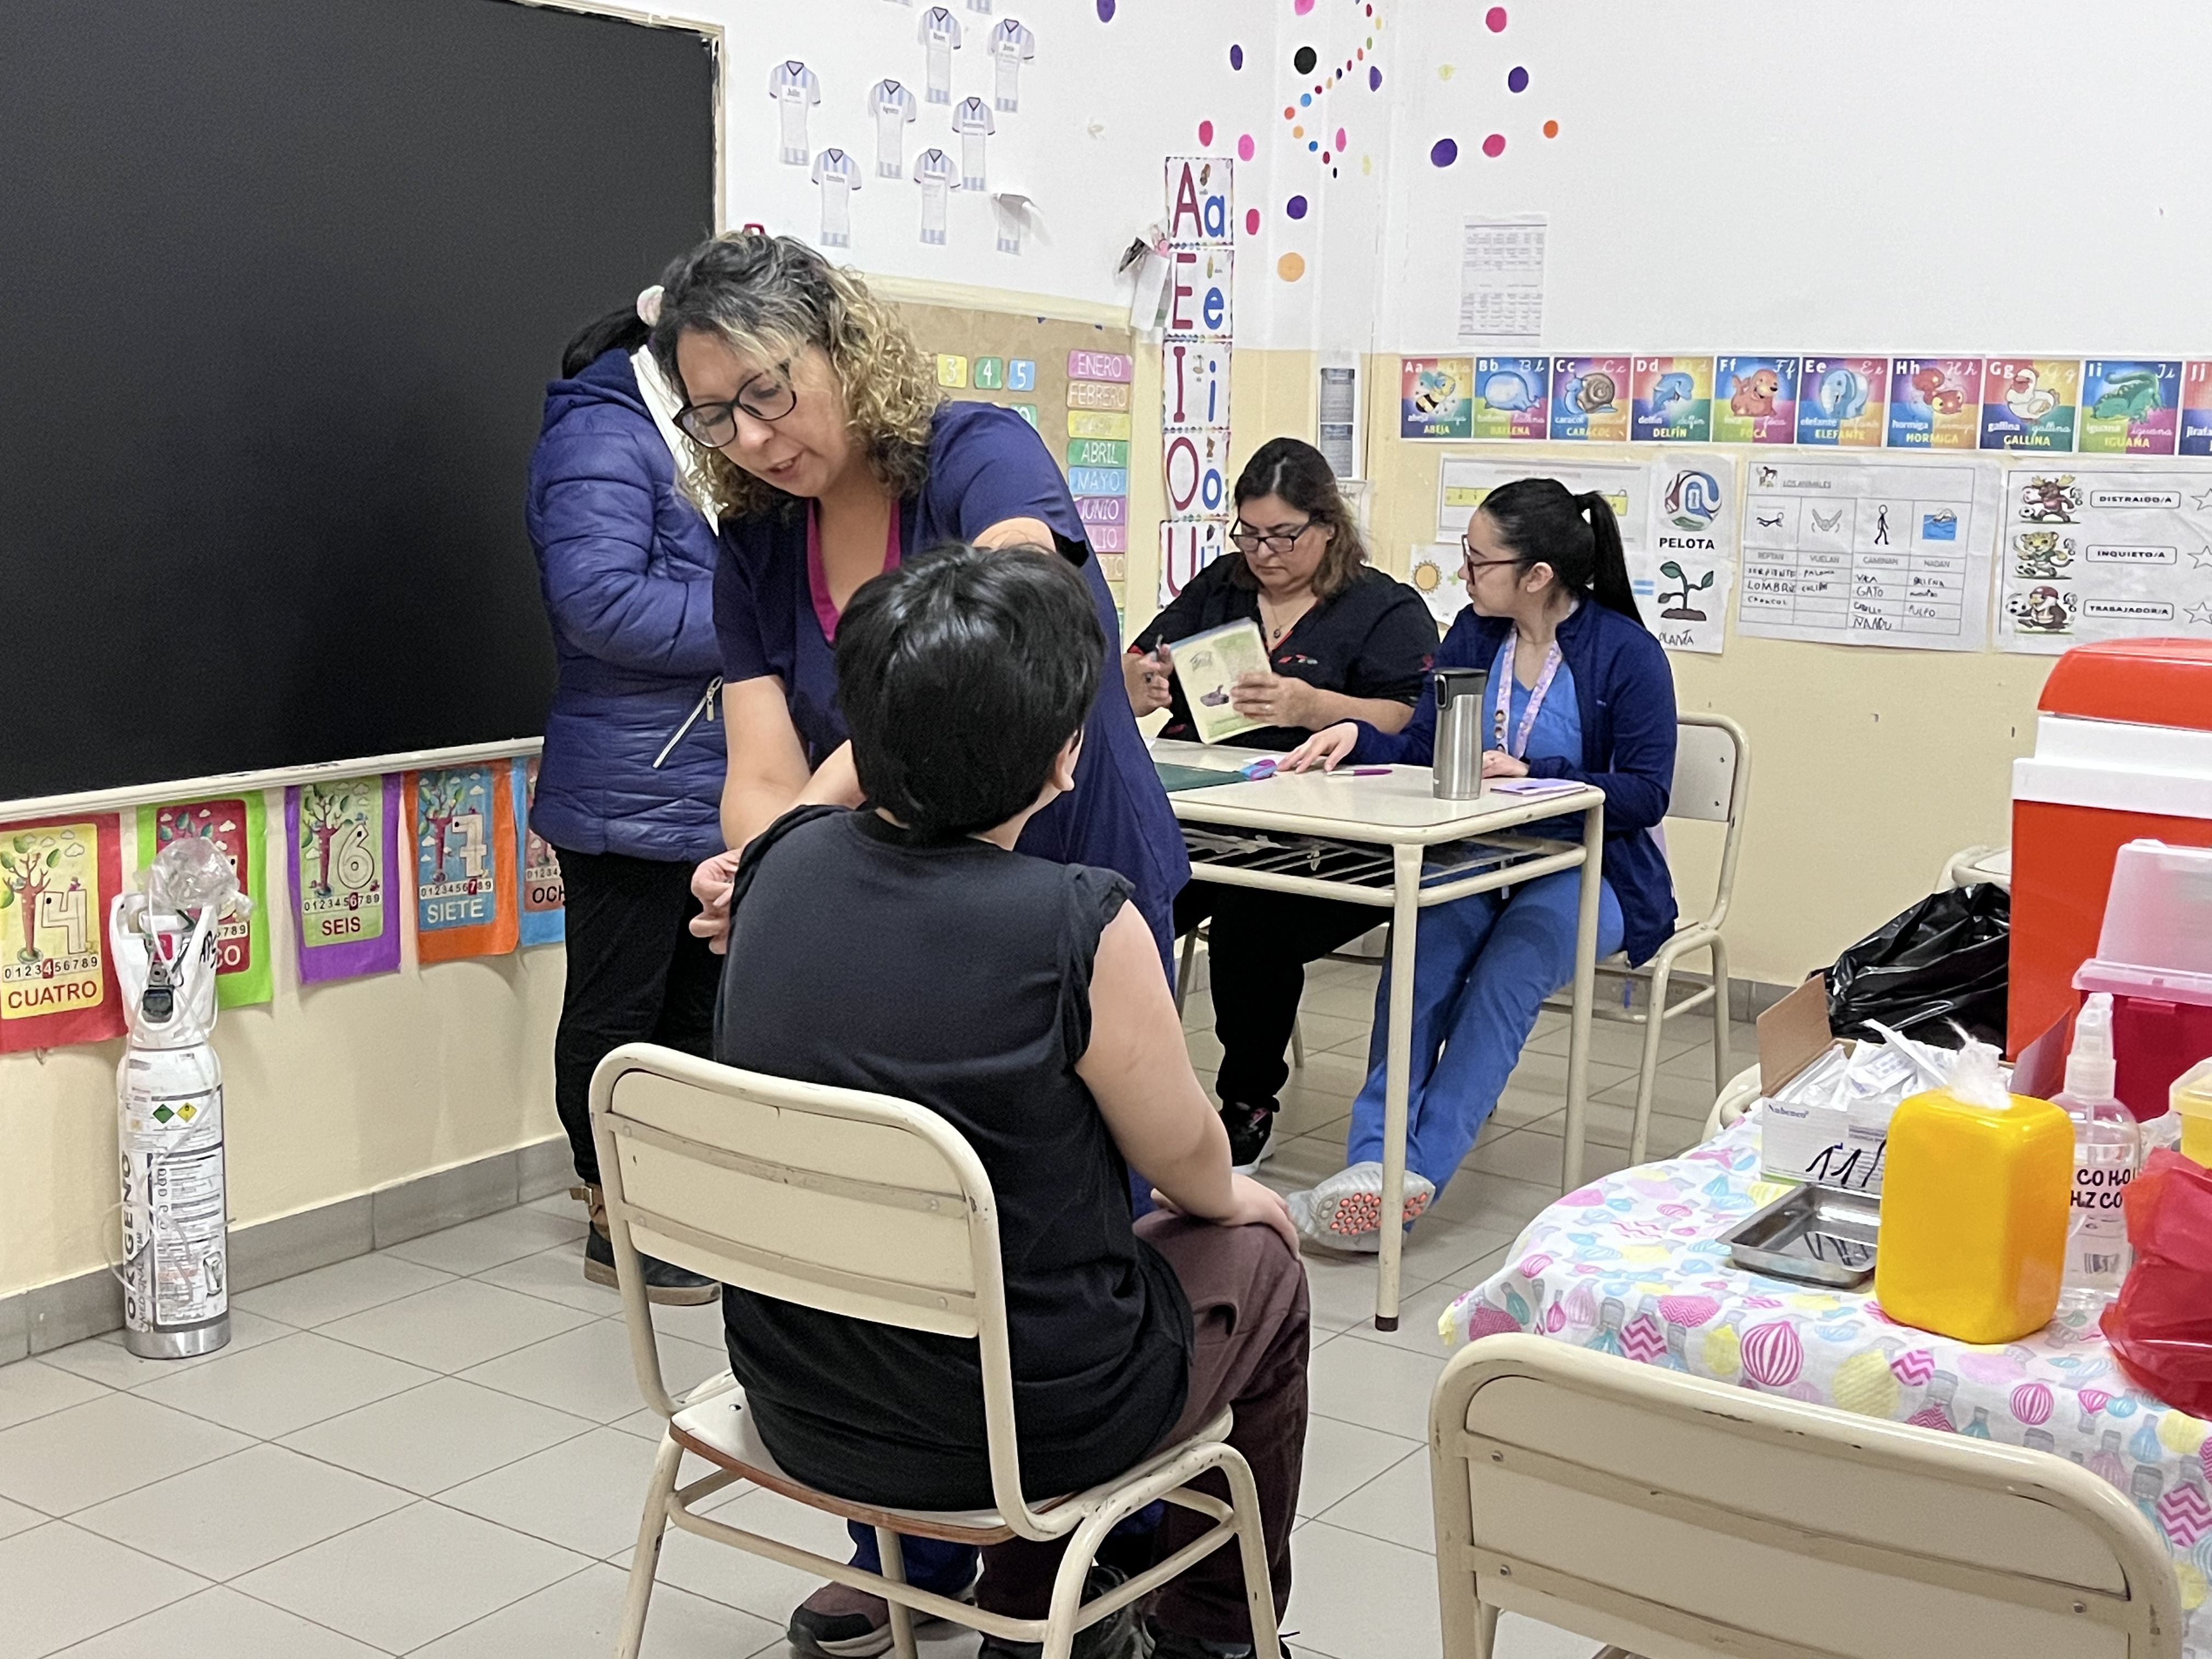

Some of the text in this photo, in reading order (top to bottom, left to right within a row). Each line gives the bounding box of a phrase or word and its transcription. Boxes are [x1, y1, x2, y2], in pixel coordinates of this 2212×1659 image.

[946, 358, 957, 382] 3
[1077, 353, 1122, 377] ENERO
[1404, 361, 1423, 373] Aa
[1479, 359, 1498, 371] Bb
[1556, 360, 1575, 373] Cc
[1637, 359, 1658, 373] Dd
[1720, 358, 1736, 371] Ff
[1805, 360, 1827, 373] Ee
[1896, 360, 1920, 375] Hh
[1990, 362, 2014, 379] Gg
[983, 359, 992, 386] 4
[1018, 362, 1026, 388] 5
[1070, 383, 1127, 407] FEBRERO
[1424, 425, 1450, 434] ABEJA
[1653, 426, 1687, 438] DELFÍN
[1740, 428, 1767, 438] FOCA
[1815, 430, 1865, 439] ELEFANTE
[1906, 433, 1959, 444] HORMIGA
[2004, 435, 2051, 447] GALLINA
[2104, 436, 2150, 448] IGUANA
[1081, 443, 1119, 464] ABRIL
[1077, 471, 1120, 491] MAYO
[1081, 499, 1119, 520] JUNIO
[1091, 528, 1118, 549] LIO
[1659, 537, 1715, 550] PELOTA
[1856, 586, 1883, 597] GATO
[2090, 605, 2169, 616] TRABAJADOR/A
[452, 814, 487, 877] 7
[337, 823, 374, 889] 6
[427, 898, 484, 924] SIETE
[41, 889, 87, 955] 4
[321, 916, 361, 936] SEIS
[8, 980, 98, 1009] CUATRO
